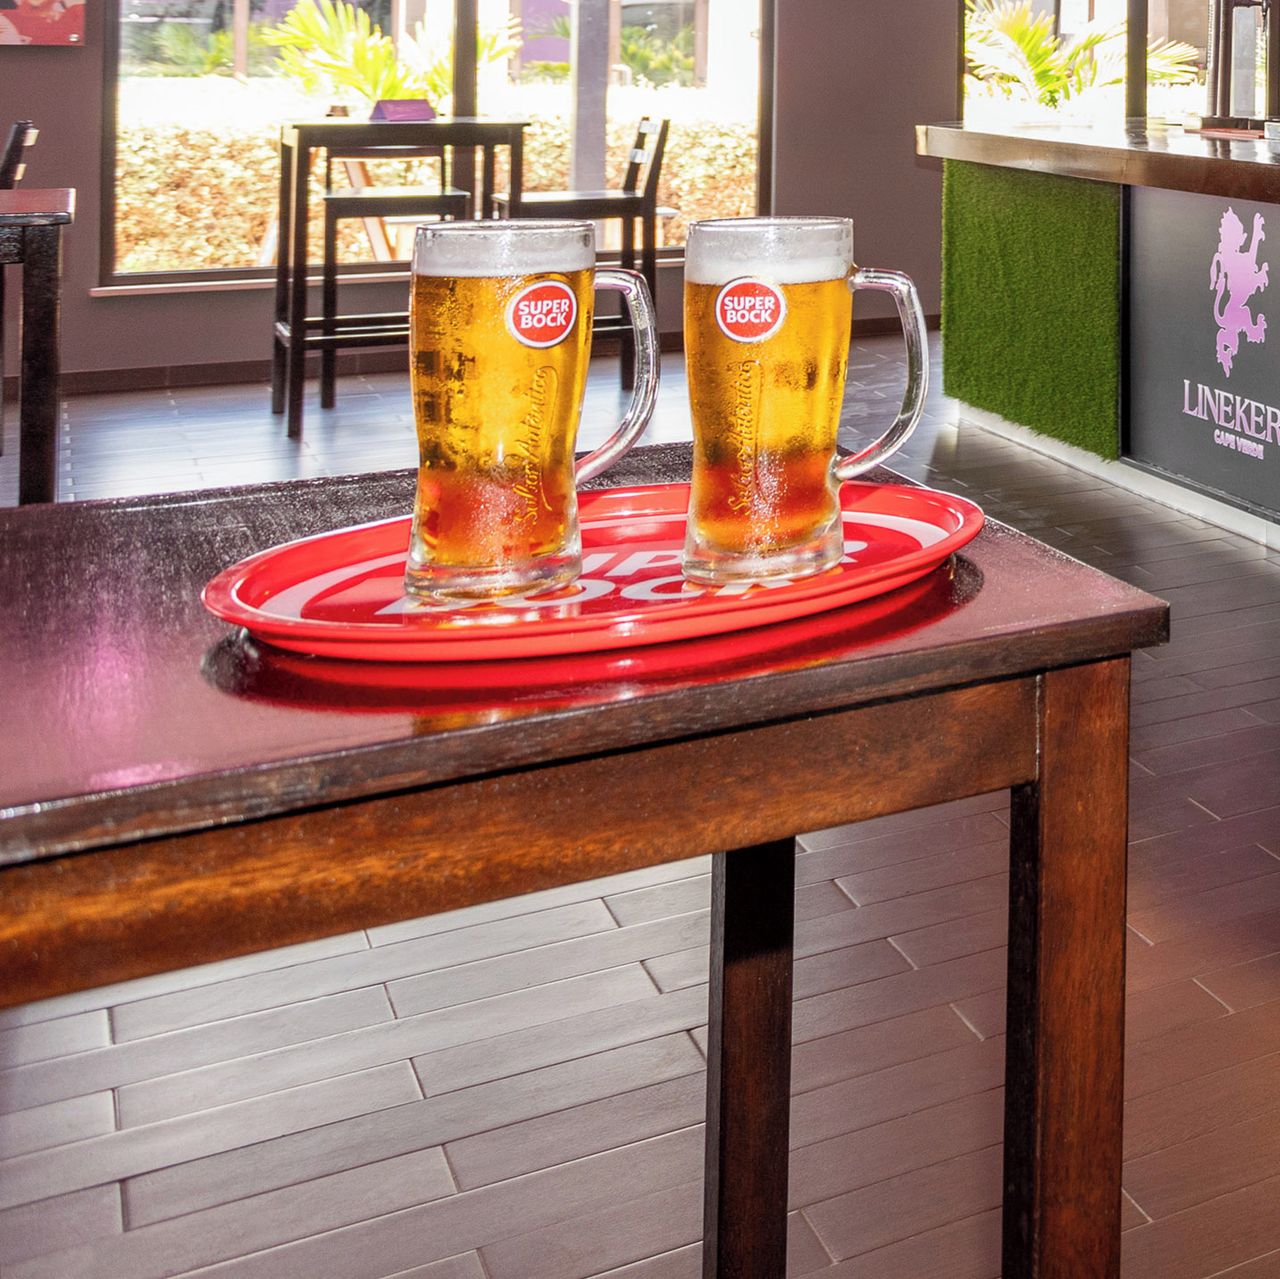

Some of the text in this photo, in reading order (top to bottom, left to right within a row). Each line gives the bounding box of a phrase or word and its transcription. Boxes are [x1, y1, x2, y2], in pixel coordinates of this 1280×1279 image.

[518, 298, 570, 315] SUPER
[724, 295, 776, 311] SUPER
[520, 311, 567, 329] BOCK
[726, 308, 773, 324] BOCK
[1214, 428, 1236, 450] CAPE
